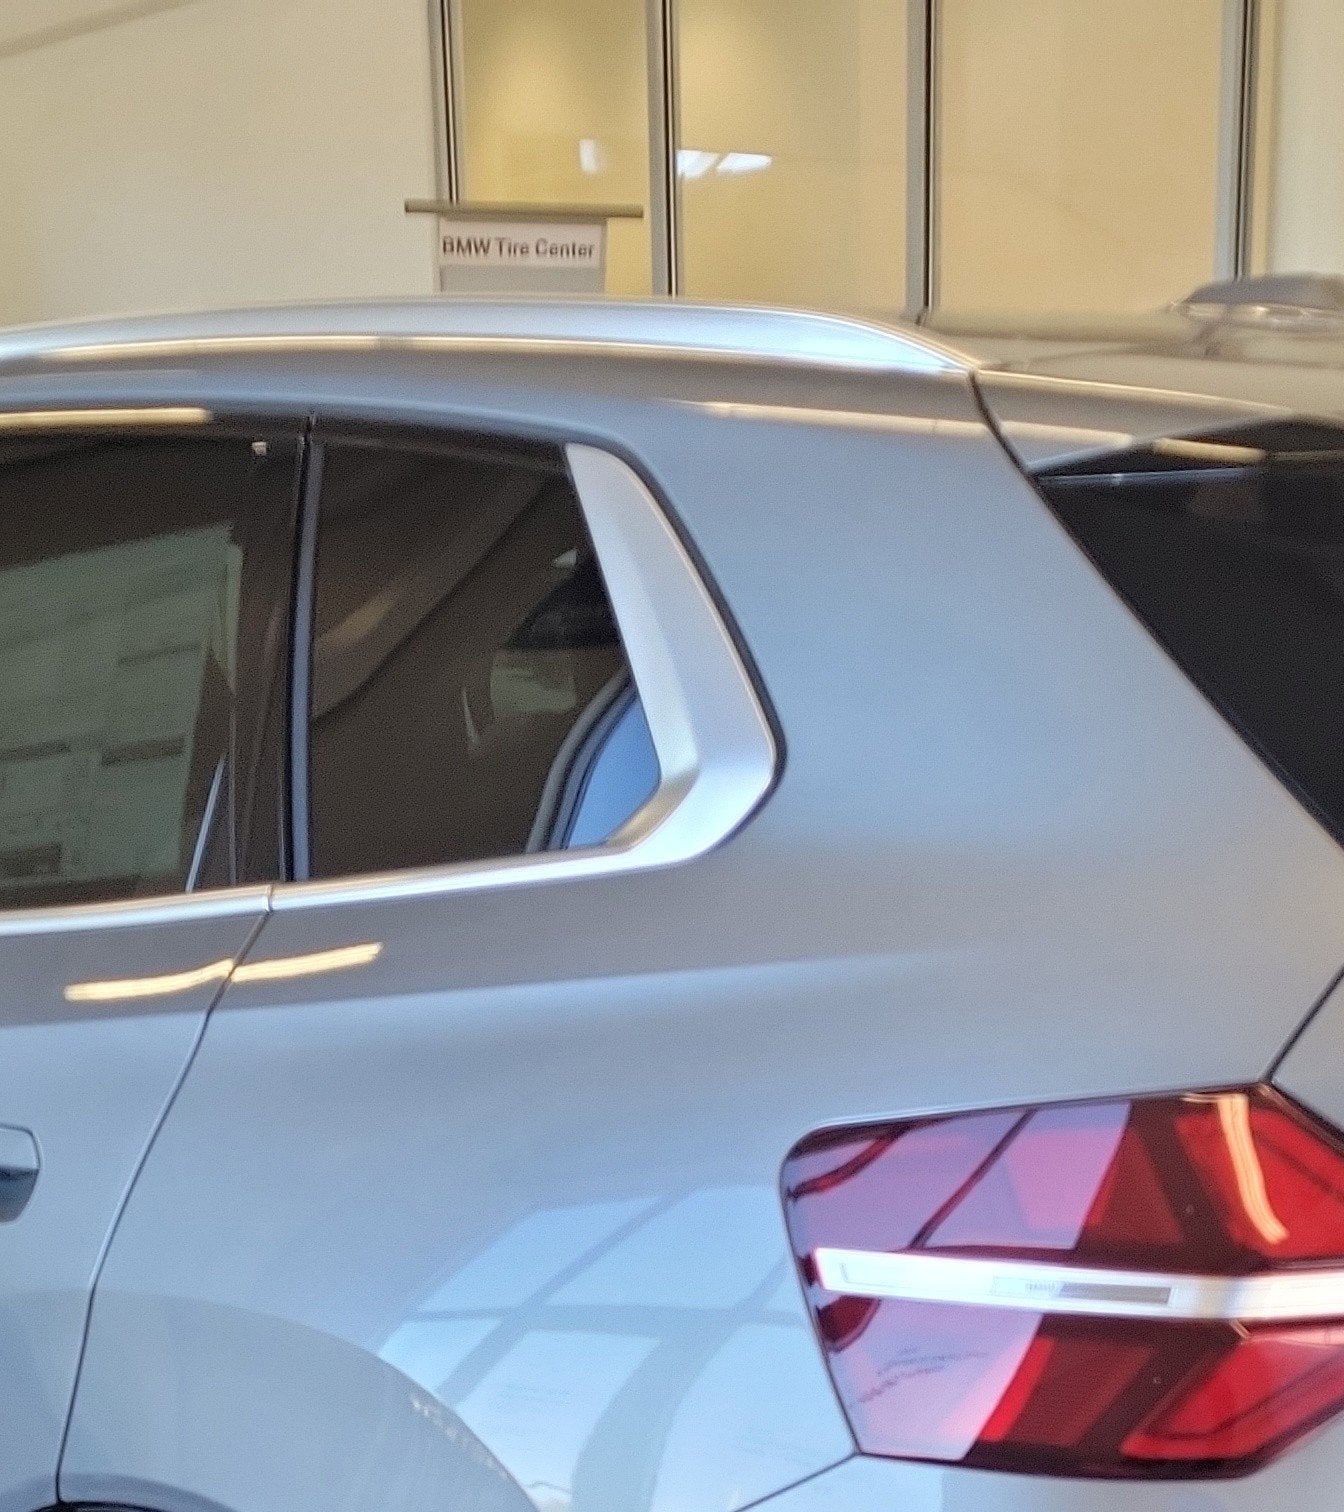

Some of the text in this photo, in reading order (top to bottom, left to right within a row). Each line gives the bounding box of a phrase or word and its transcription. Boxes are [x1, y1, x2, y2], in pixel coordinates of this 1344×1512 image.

[442, 235, 595, 258] BMW Tire Center
